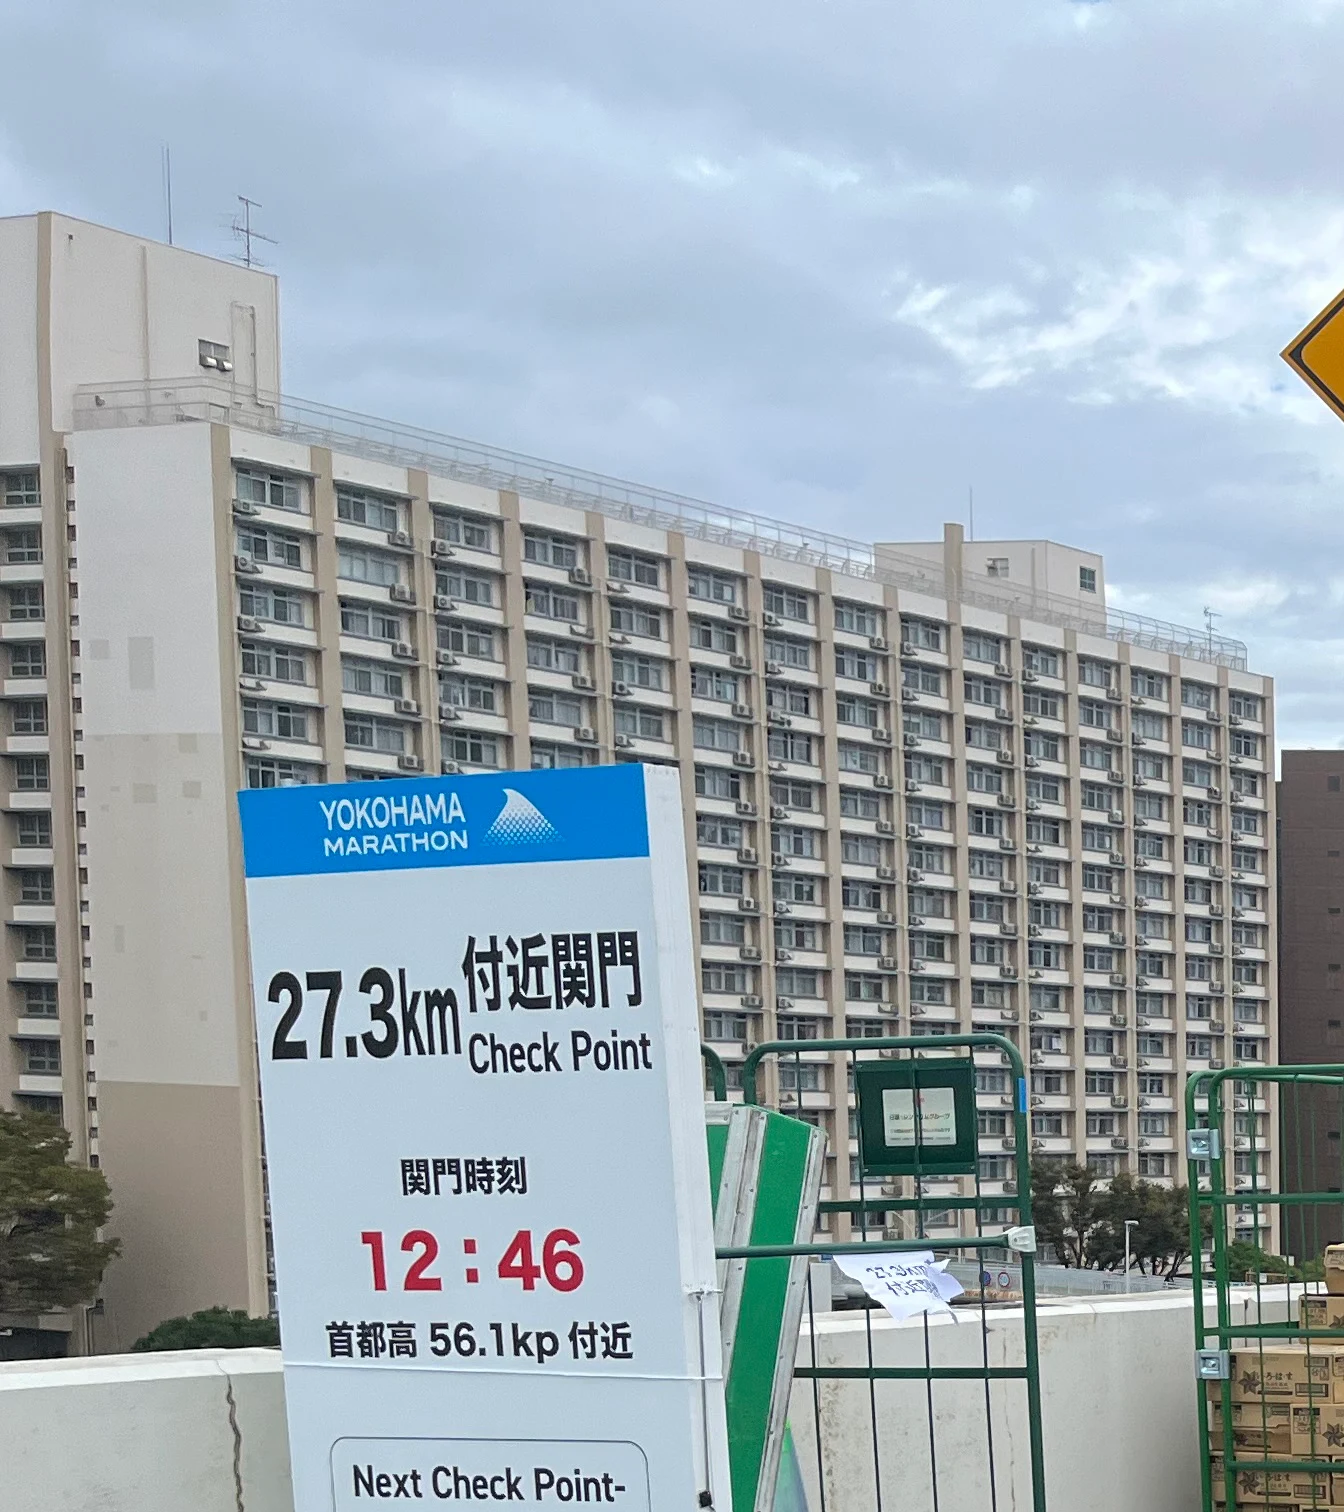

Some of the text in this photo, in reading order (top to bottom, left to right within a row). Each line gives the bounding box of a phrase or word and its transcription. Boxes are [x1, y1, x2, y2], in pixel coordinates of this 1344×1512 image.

[319, 791, 467, 832] YOKOHAMA
[323, 829, 469, 858] MARATHON
[267, 930, 643, 1062] 27.3km 付近関門
[468, 1028, 653, 1075] Check Point
[400, 1155, 528, 1197] 関門時刻
[360, 1228, 586, 1293] 12:46
[325, 1320, 634, 1364] 首都高 56.1kp 付近
[352, 1464, 627, 1504] Next Check Point-
